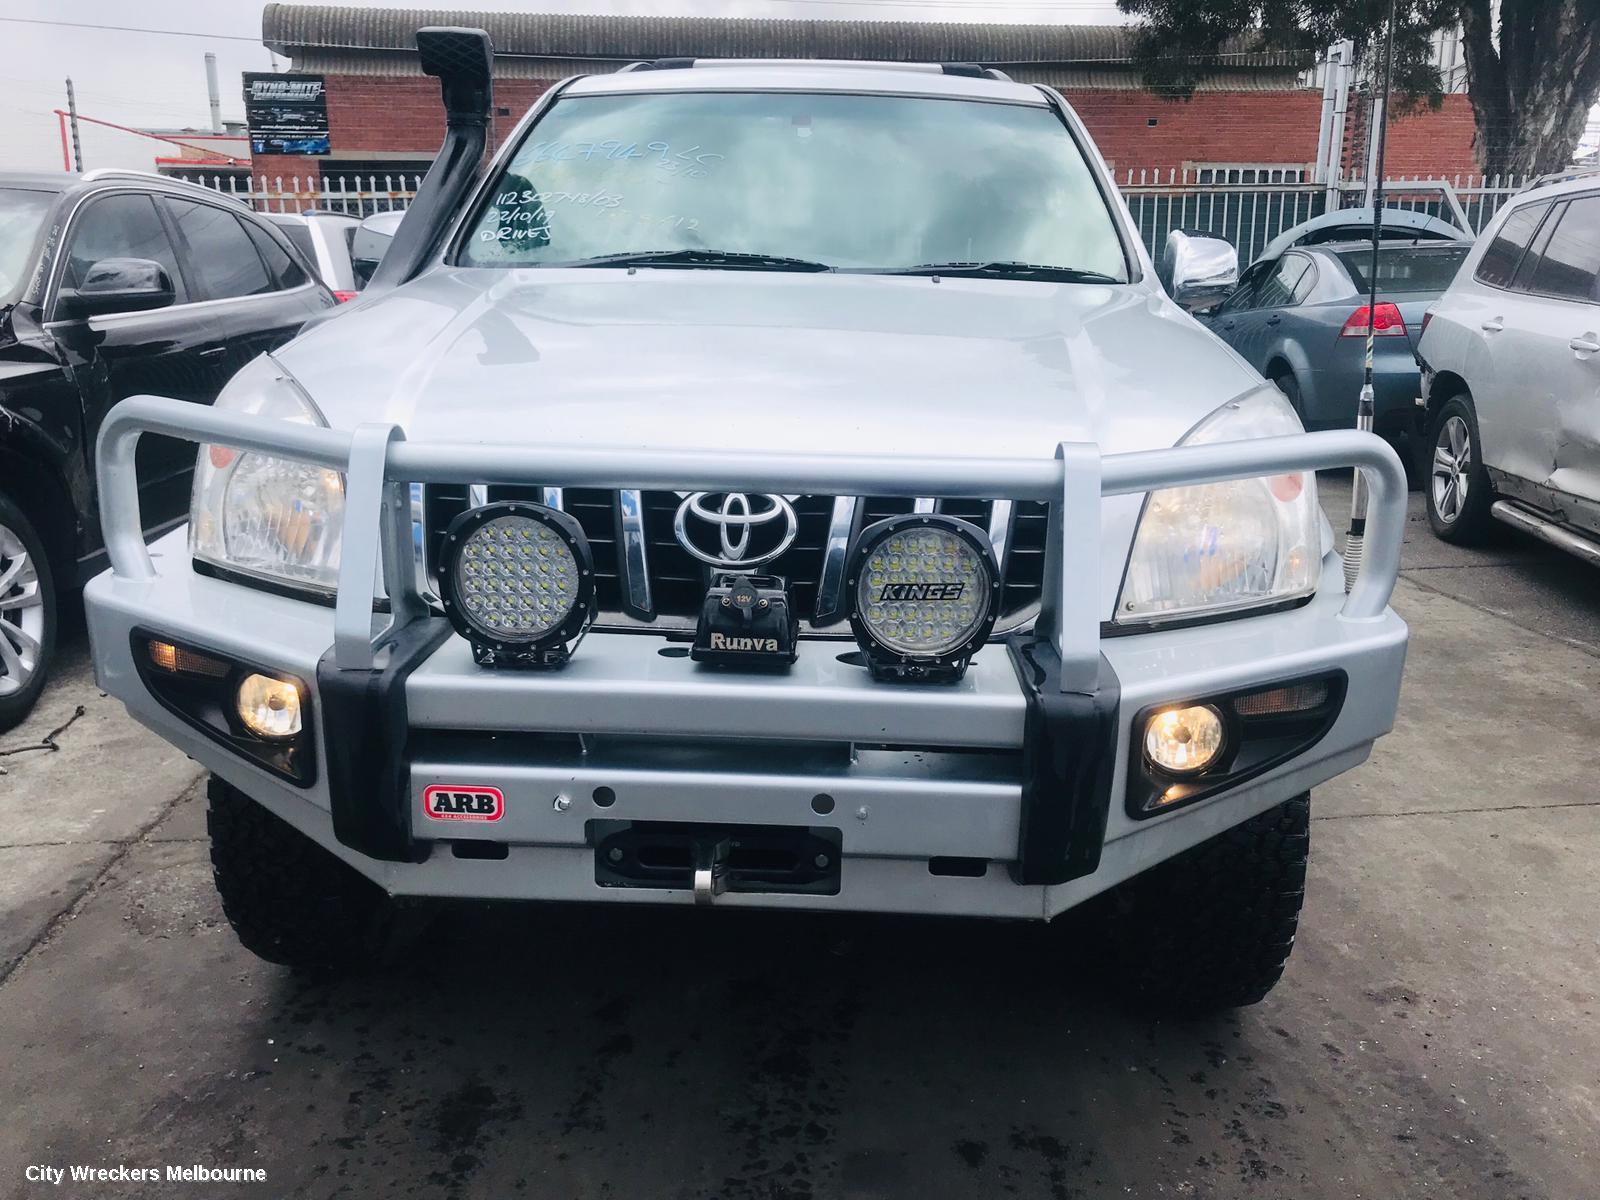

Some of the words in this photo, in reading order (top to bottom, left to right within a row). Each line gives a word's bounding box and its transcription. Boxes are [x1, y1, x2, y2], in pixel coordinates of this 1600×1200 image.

[251, 81, 322, 94] DYNO-MITE
[736, 595, 752, 603] 12V
[880, 583, 965, 601] KINGS
[710, 632, 778, 652] Runva
[434, 792, 496, 814] ARB
